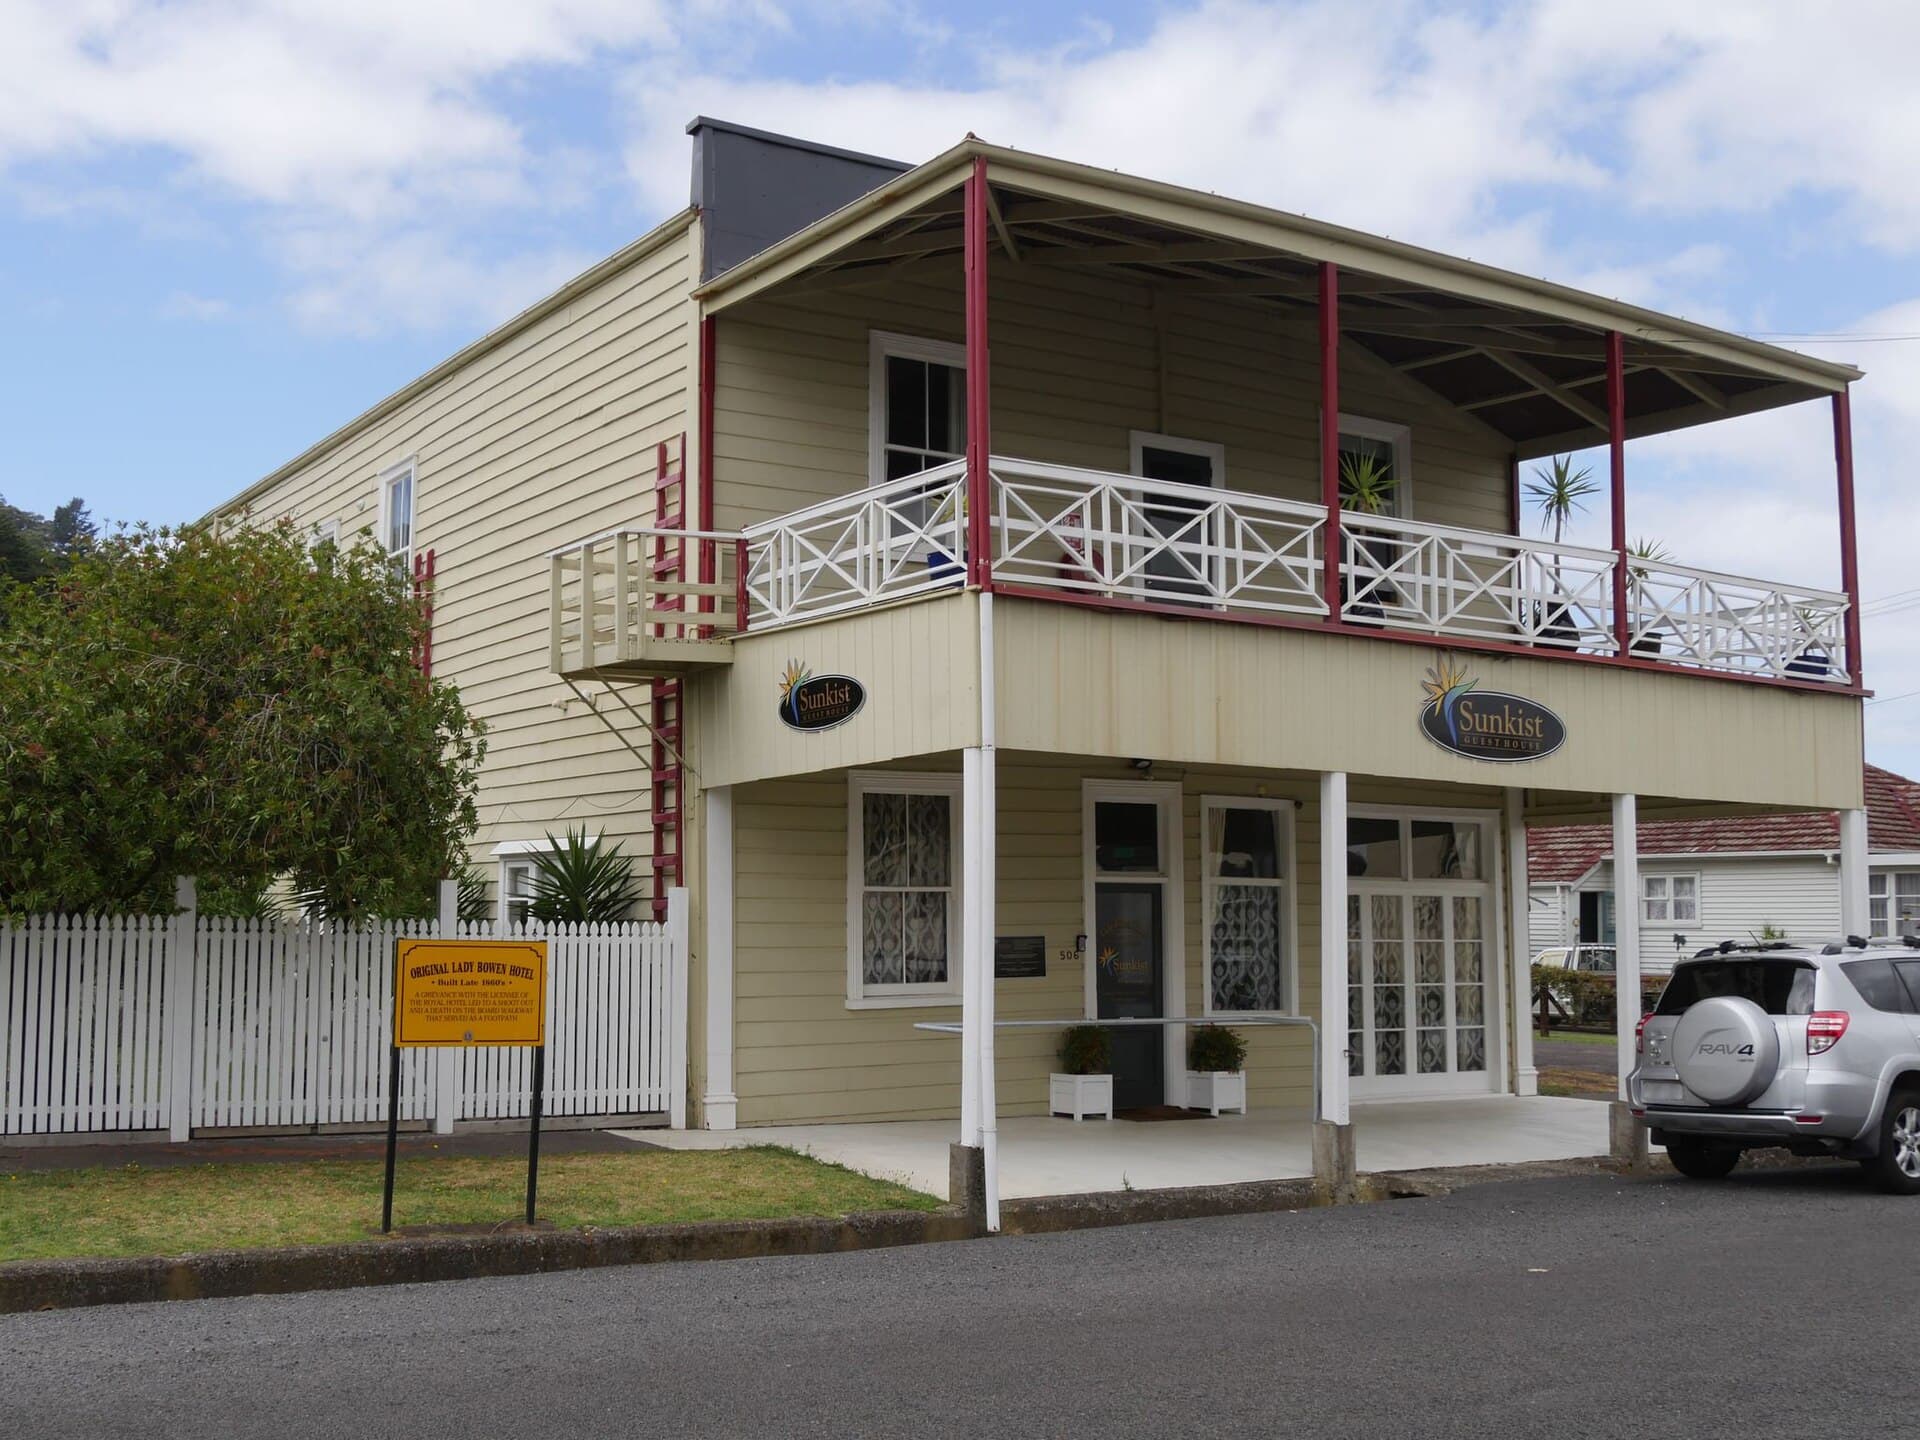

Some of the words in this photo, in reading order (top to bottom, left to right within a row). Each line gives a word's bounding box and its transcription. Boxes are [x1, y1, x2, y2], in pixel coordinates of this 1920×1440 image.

[800, 682, 850, 711] Sunkist
[1459, 700, 1544, 738] Sunkist
[1464, 735, 1500, 746] GUEST
[1504, 739, 1540, 750] HOUSE
[1060, 951, 1079, 960] 506
[410, 963, 449, 979] ORIGINAL
[452, 961, 474, 974] LADY
[477, 961, 506, 975] BOWEN
[509, 964, 534, 980] HOTEL
[438, 978, 458, 986] Built
[1699, 1044, 1754, 1056] RAV4
